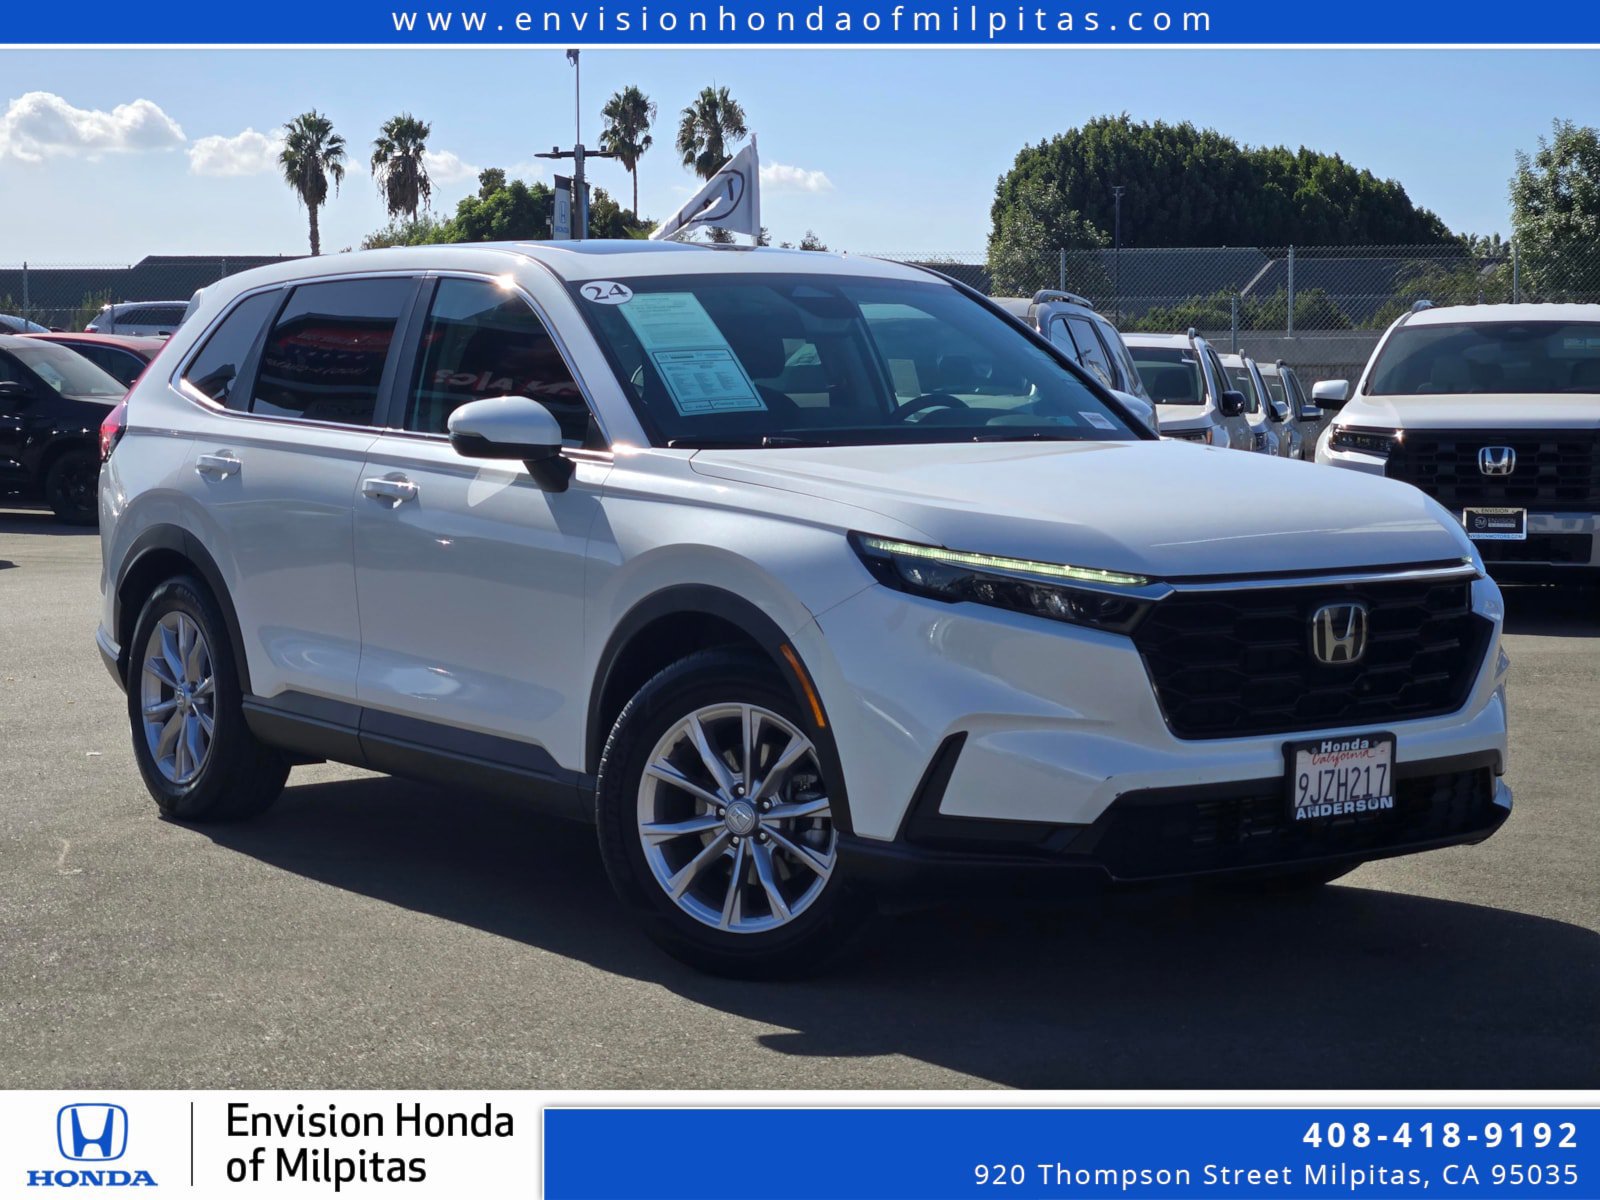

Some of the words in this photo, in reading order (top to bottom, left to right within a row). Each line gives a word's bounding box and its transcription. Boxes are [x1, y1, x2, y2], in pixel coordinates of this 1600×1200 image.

[585, 284, 629, 300] 24
[1321, 738, 1370, 754] Honda
[1312, 749, 1376, 768] California
[1298, 763, 1388, 808] 9JZH217
[1295, 796, 1394, 821] ANDERSON
